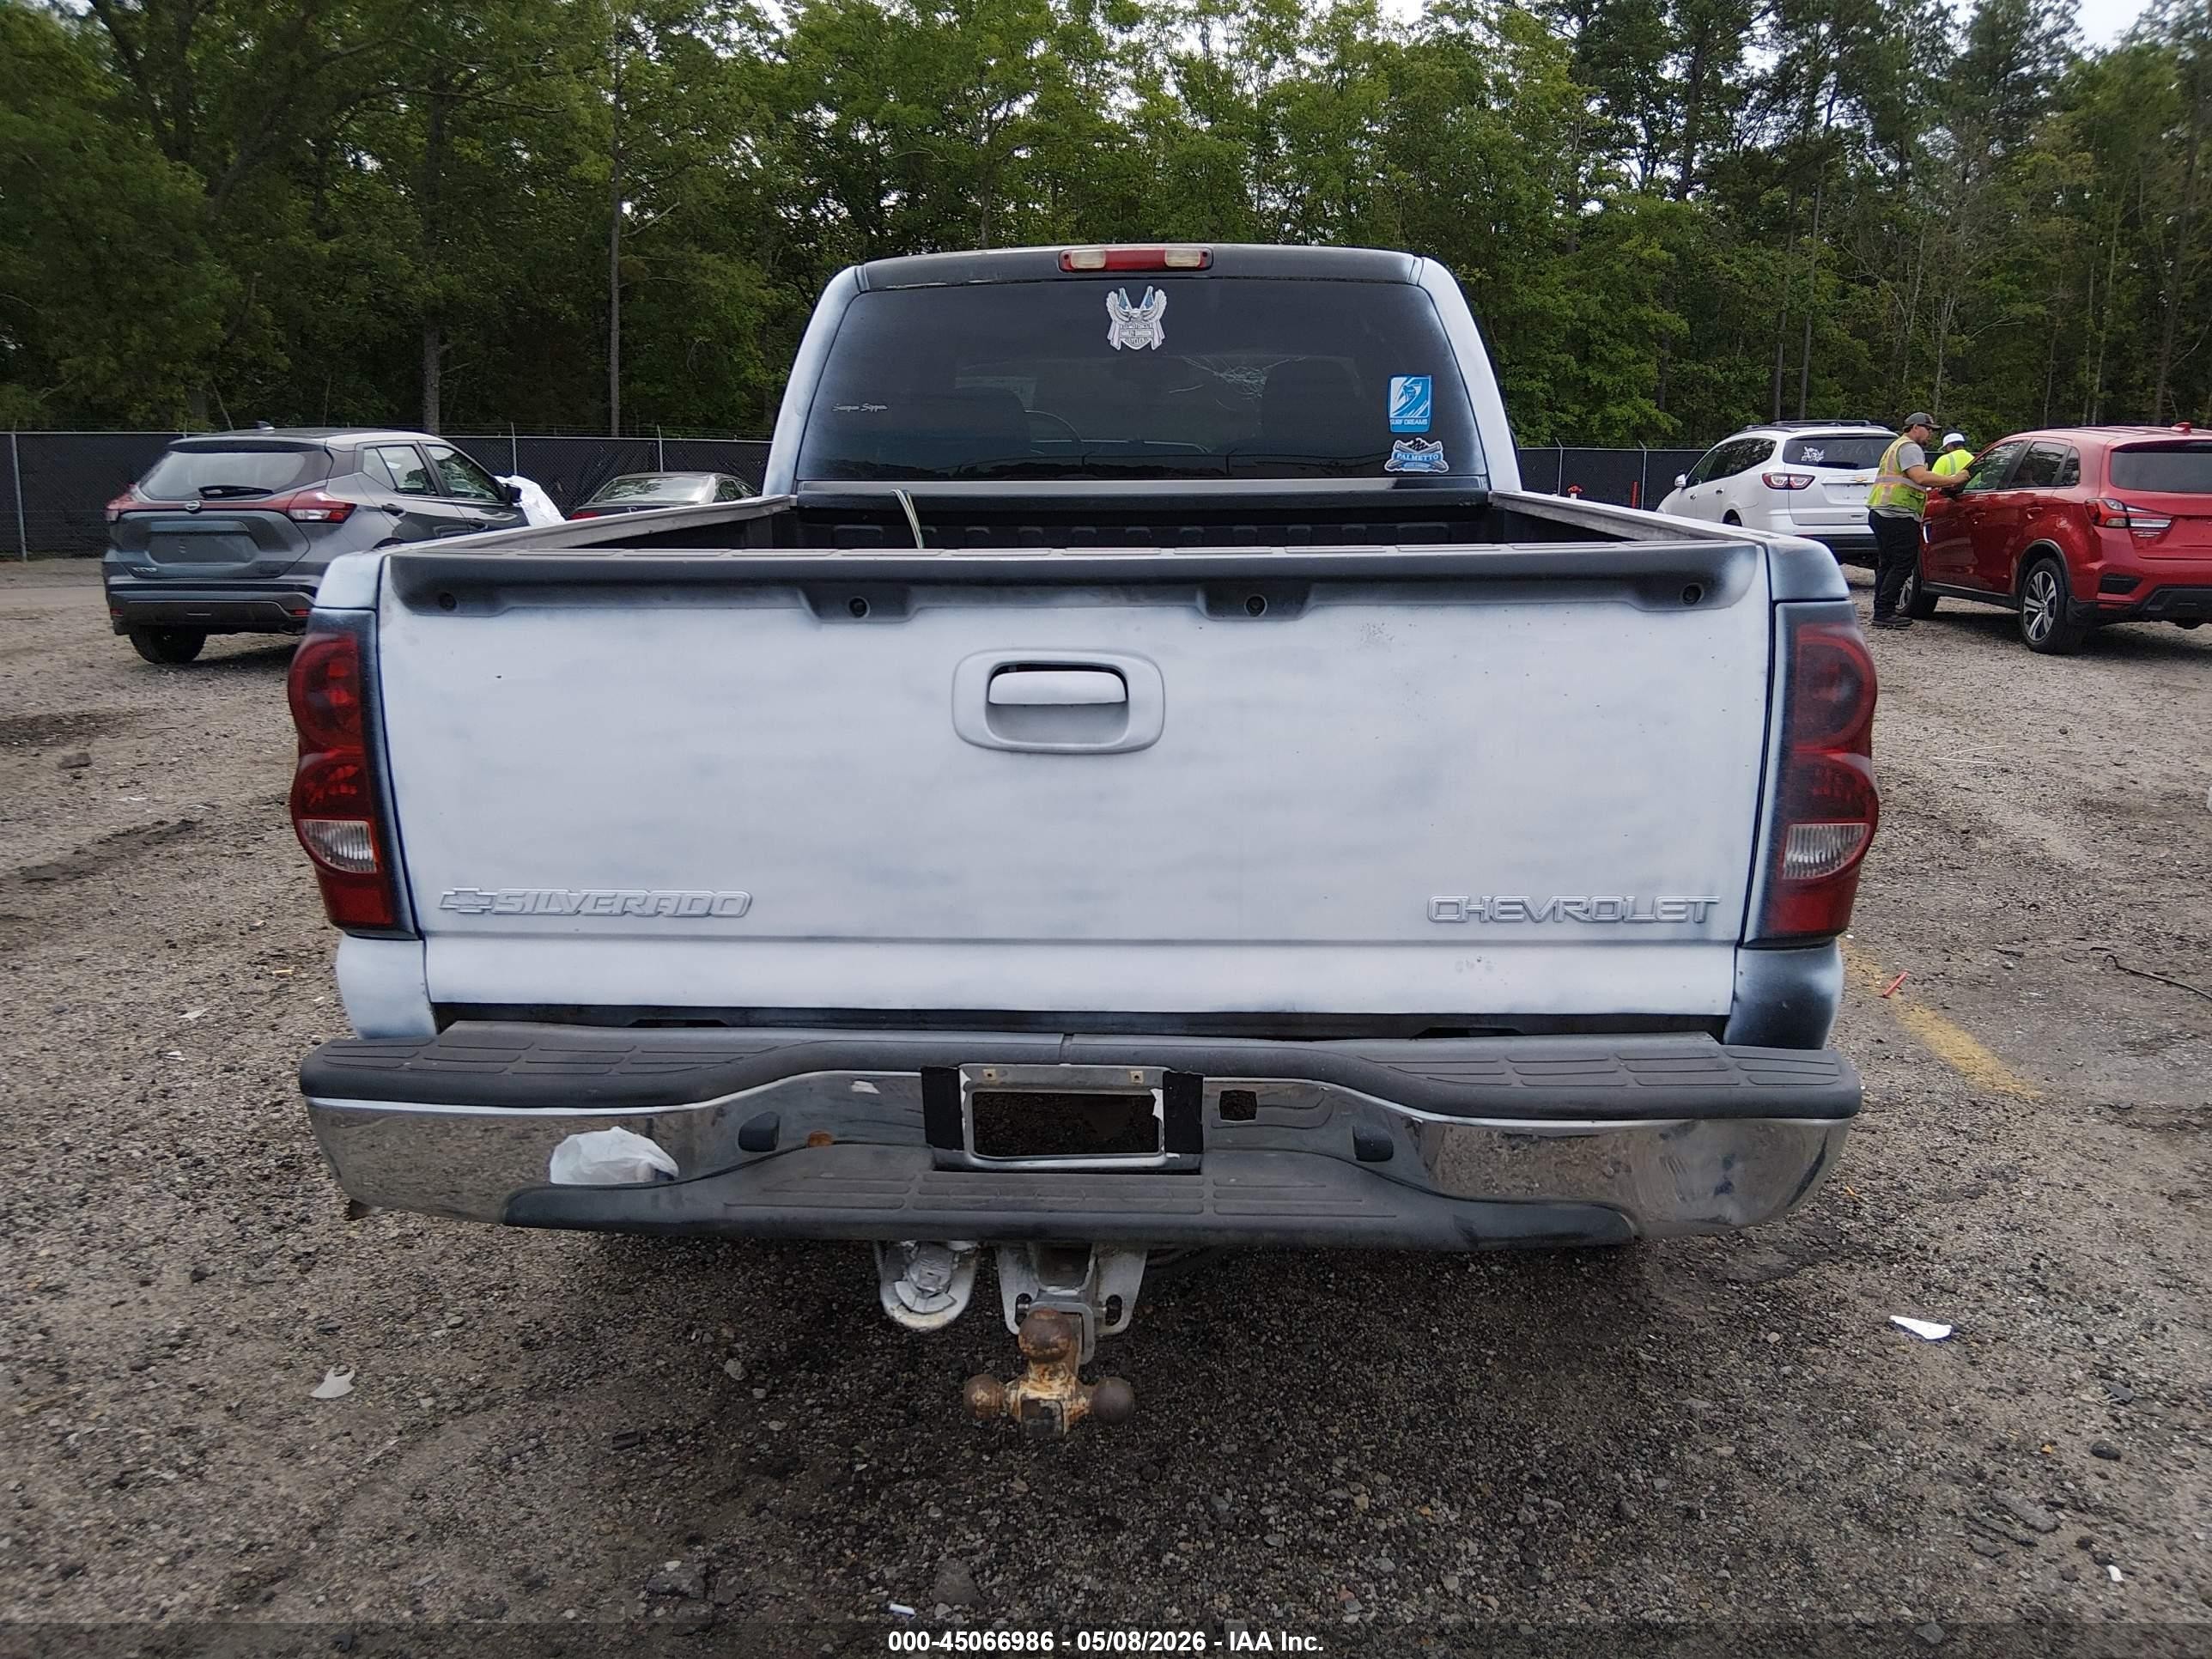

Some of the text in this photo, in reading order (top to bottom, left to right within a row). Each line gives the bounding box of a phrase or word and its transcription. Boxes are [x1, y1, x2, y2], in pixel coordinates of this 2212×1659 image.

[1396, 453, 1439, 462] PALMETTO
[491, 888, 753, 918] SILVERADO
[1427, 895, 1720, 923] CHEVROLET
